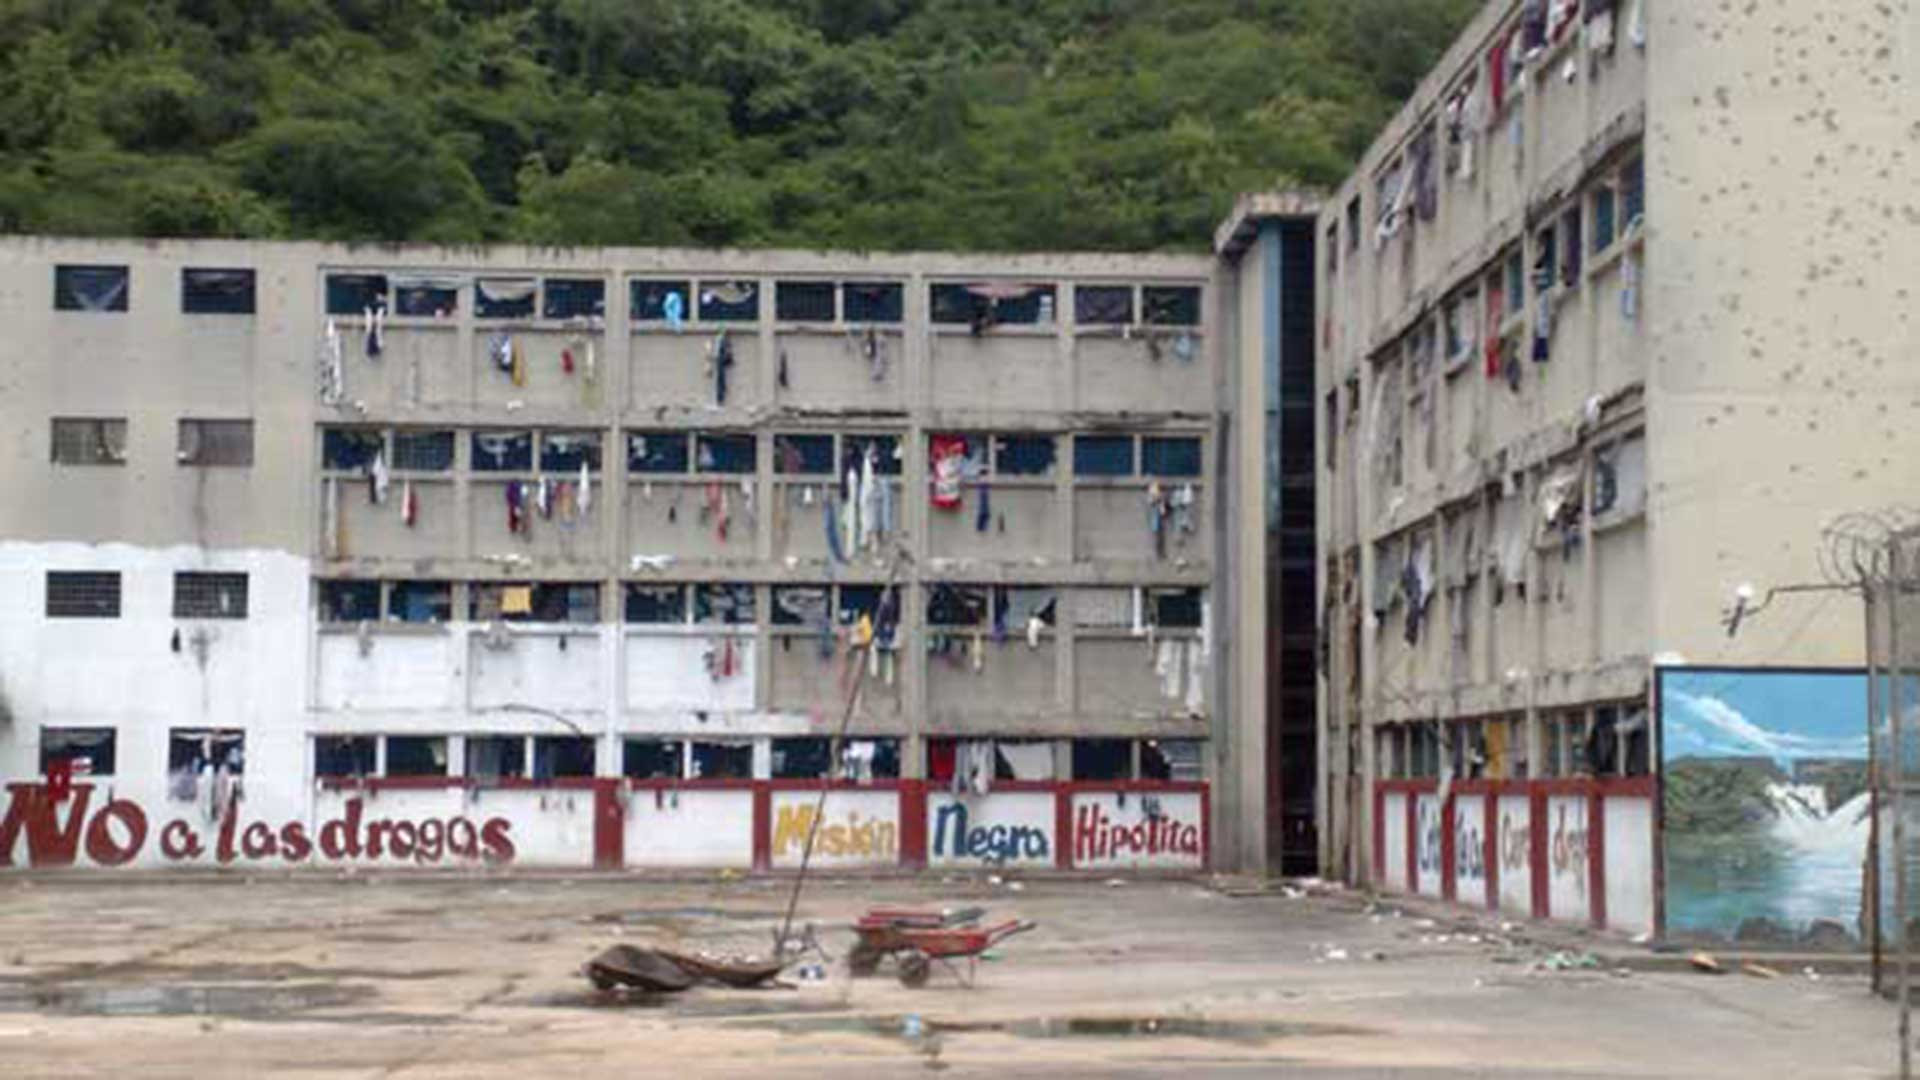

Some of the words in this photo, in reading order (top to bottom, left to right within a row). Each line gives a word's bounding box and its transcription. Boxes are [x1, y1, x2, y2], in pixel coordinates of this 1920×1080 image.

[0, 783, 147, 866] No
[160, 819, 205, 860] a
[216, 795, 312, 862] las
[319, 799, 515, 862] drogas
[934, 800, 1049, 863] Negra
